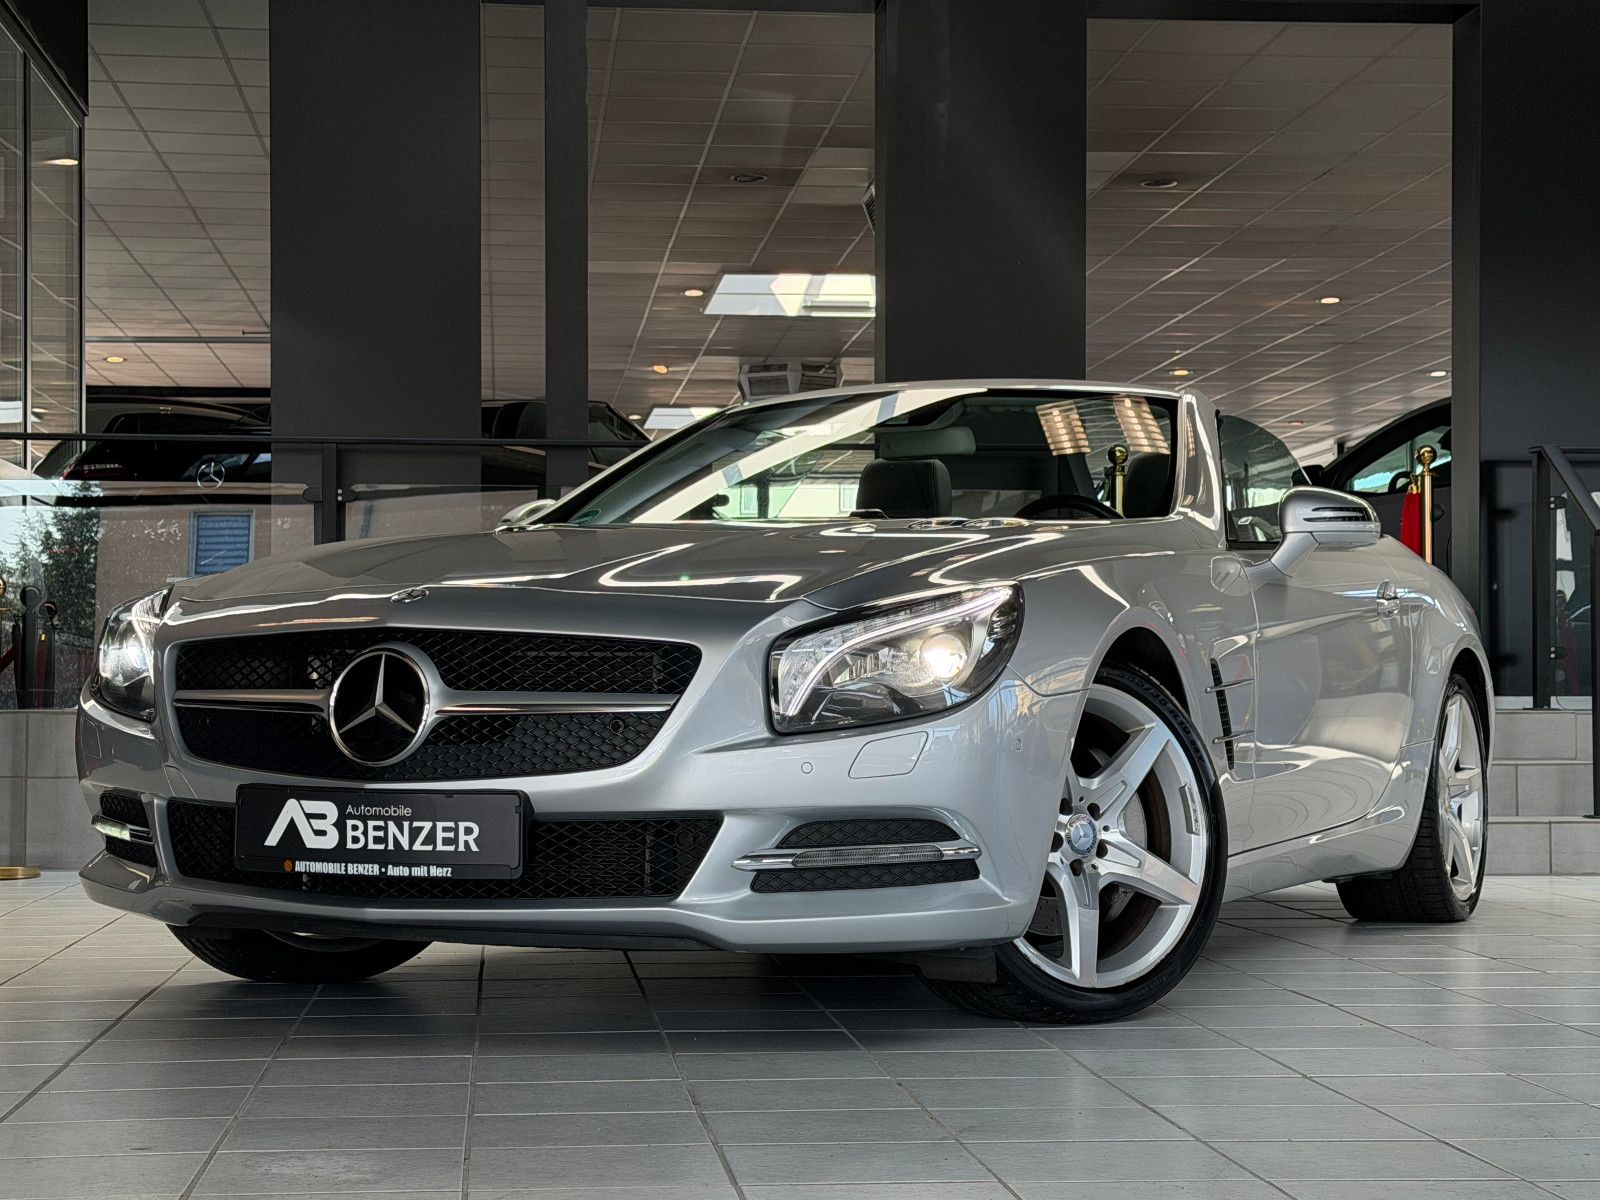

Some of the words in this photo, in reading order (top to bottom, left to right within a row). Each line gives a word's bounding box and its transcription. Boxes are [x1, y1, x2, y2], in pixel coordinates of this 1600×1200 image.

[345, 805, 412, 817] Automobile
[345, 819, 480, 852] BENZER
[295, 860, 346, 875] AUTOMOBILE
[347, 863, 380, 876] BENZER
[387, 864, 410, 876] Auto
[411, 865, 428, 877] mit
[429, 865, 452, 877] Herz
